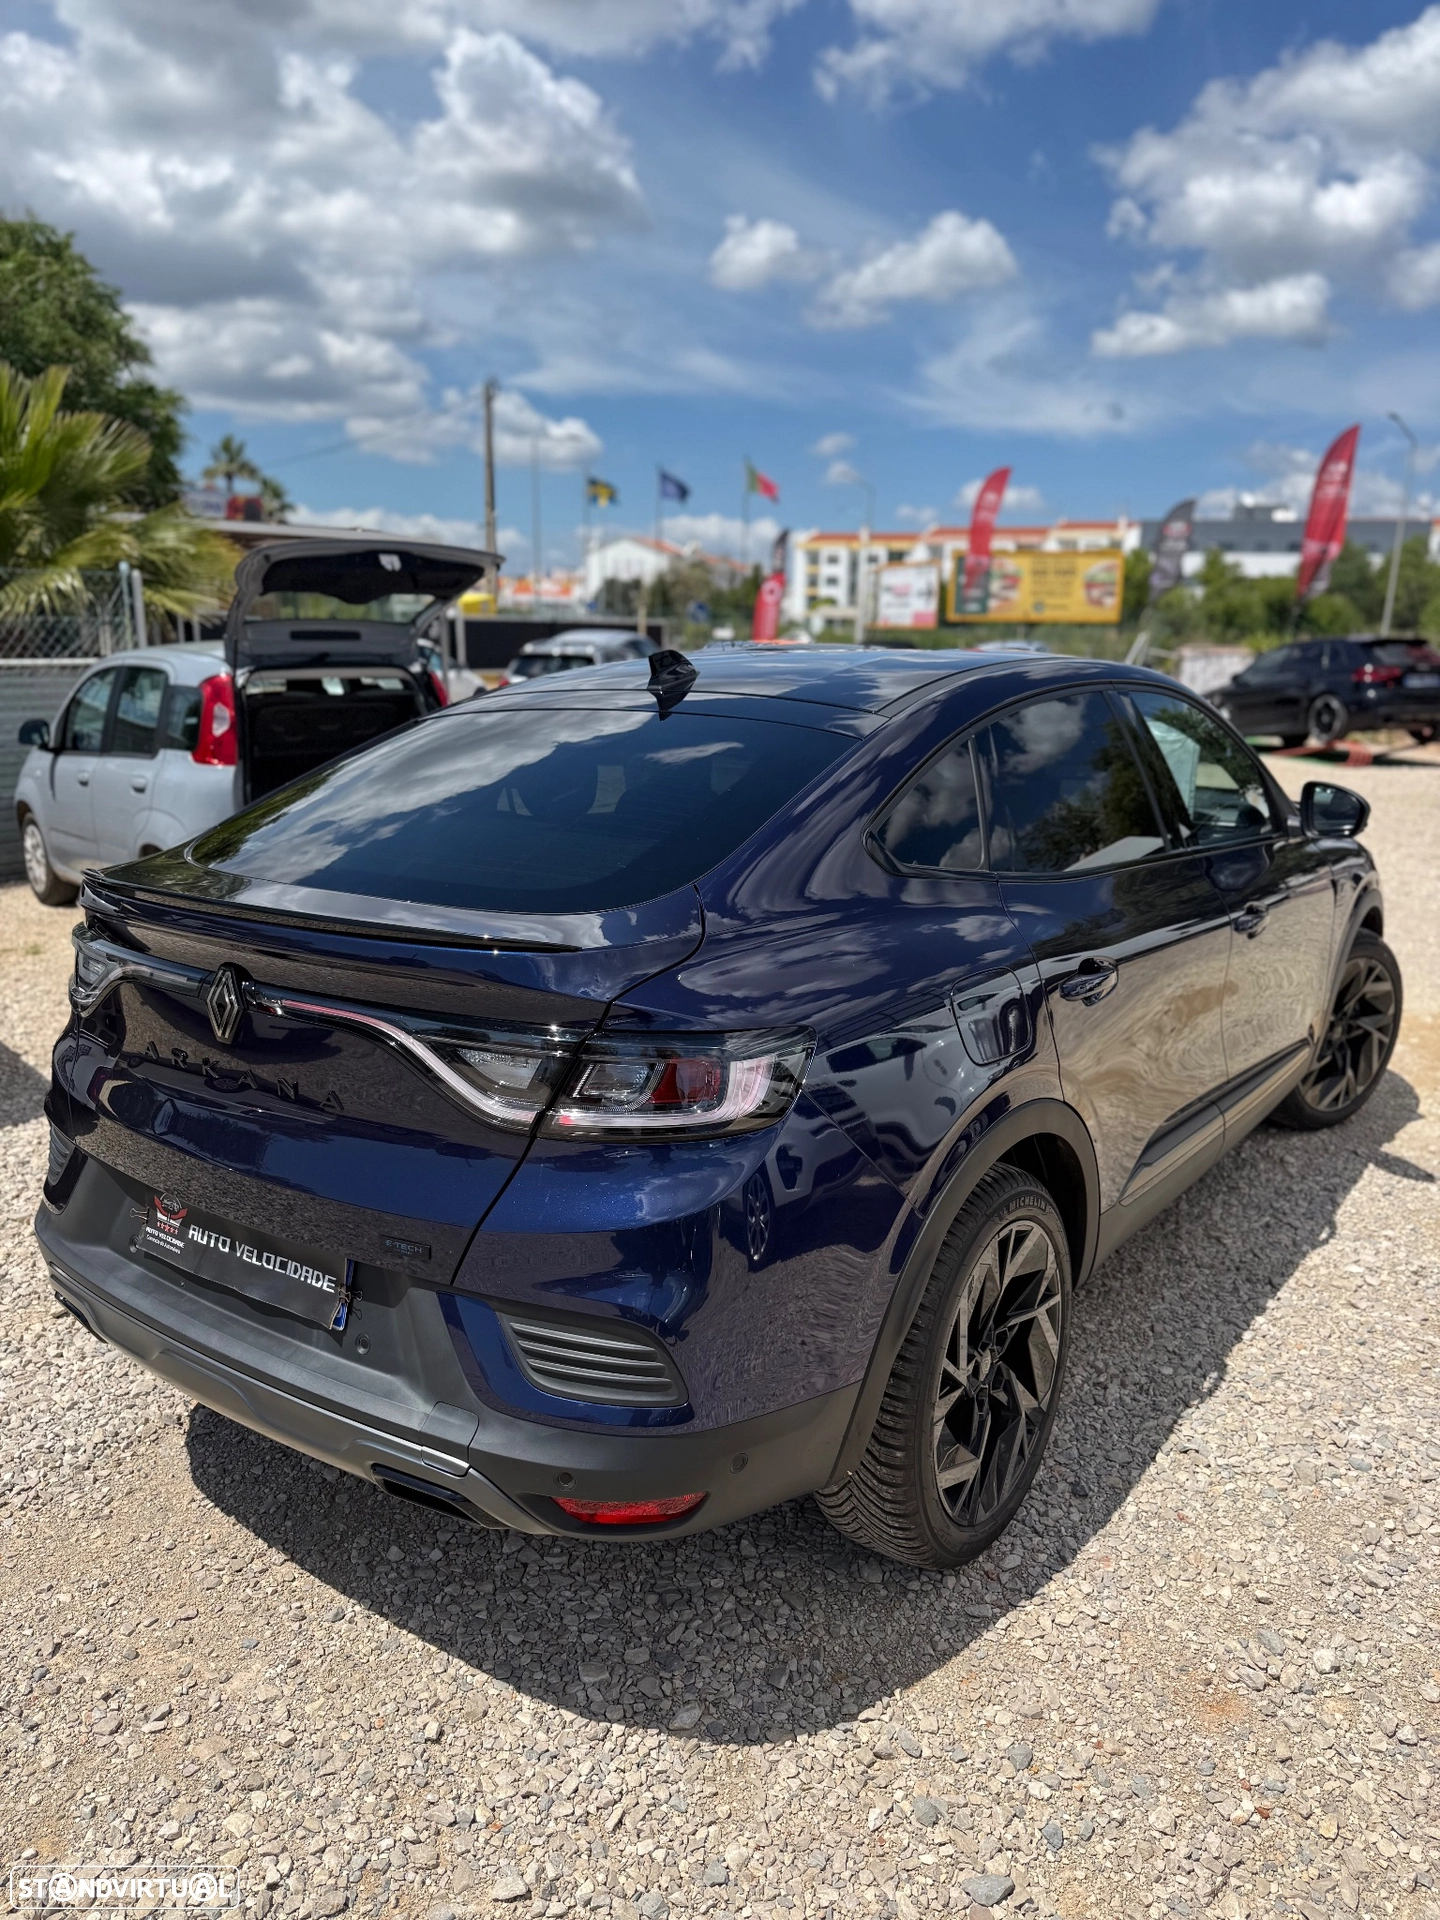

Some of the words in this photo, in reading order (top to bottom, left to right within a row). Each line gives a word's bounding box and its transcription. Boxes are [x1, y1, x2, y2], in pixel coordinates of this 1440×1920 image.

[144, 1040, 345, 1111] ARKANA
[1009, 1195, 1047, 1212] MICHELIN
[145, 1226, 158, 1236] AUTO
[188, 1224, 232, 1254] AUTO
[235, 1240, 338, 1294] VELOCIDADE
